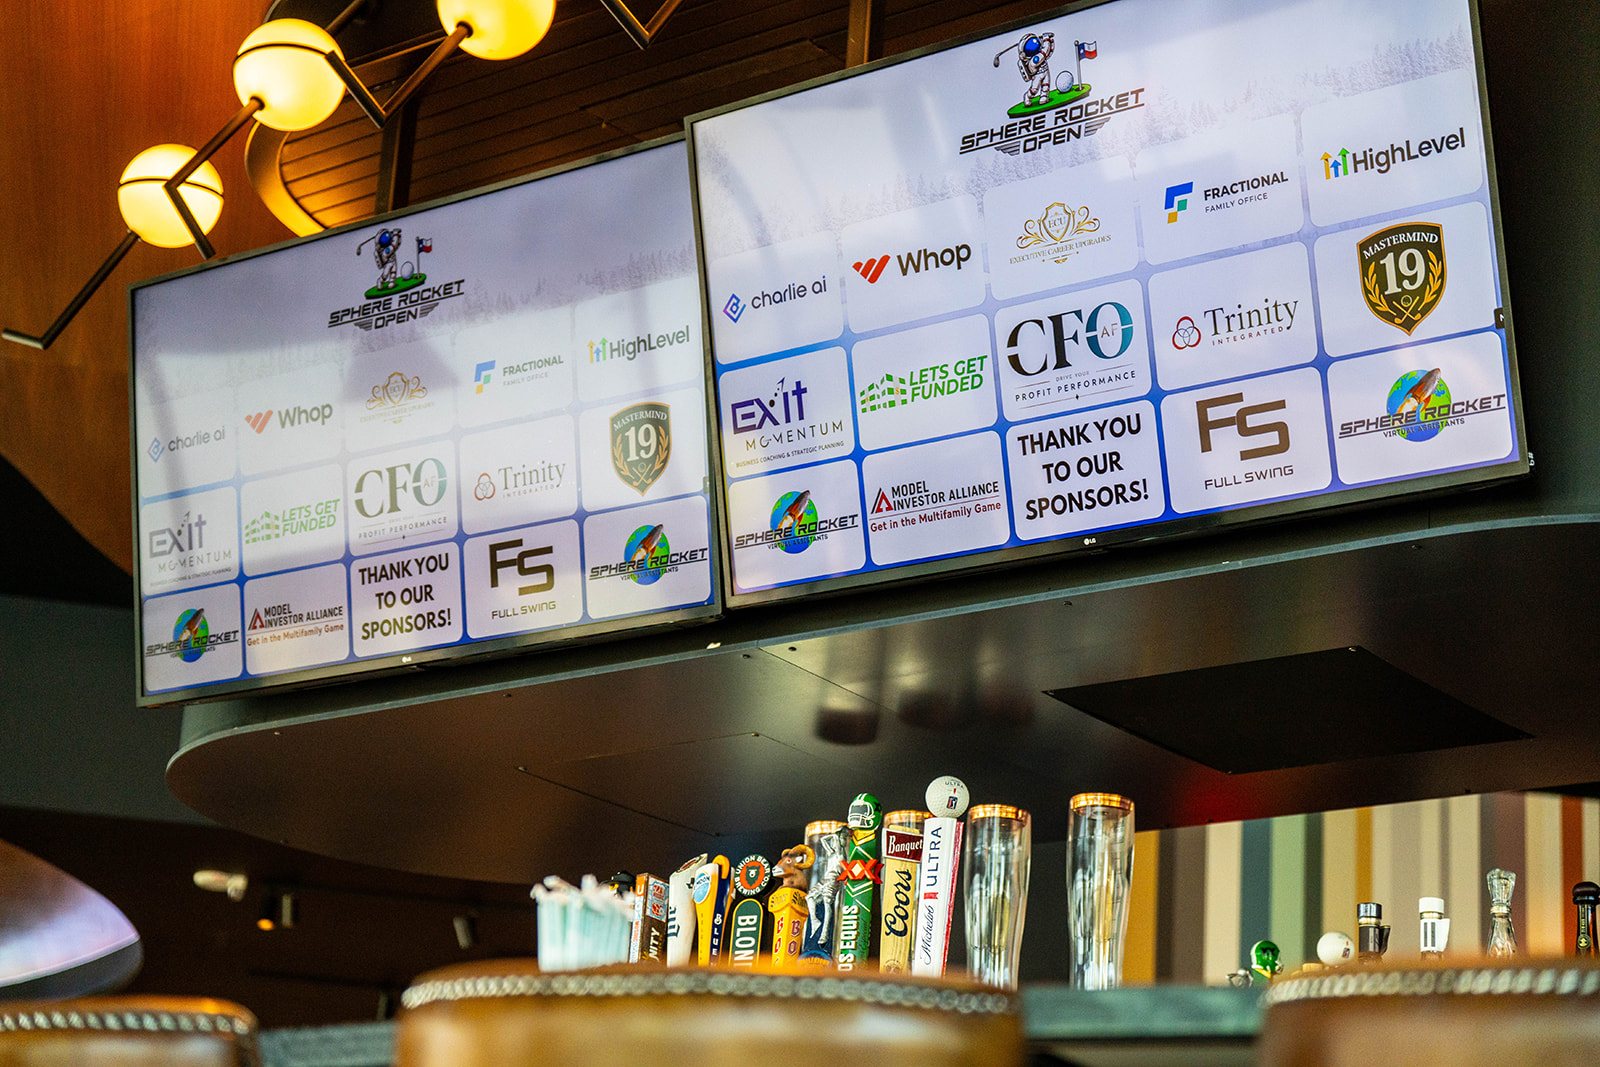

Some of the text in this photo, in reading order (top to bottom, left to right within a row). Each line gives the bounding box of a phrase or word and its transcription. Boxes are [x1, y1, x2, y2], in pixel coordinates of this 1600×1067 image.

[960, 88, 1144, 150] SPHERE ROCKET
[1023, 125, 1081, 153] OPEN
[1352, 127, 1466, 174] HighLevel
[1204, 171, 1289, 202] FRACTIONAL
[1204, 192, 1268, 214] FAMILY OFFICE
[897, 243, 971, 276] Whop
[1362, 231, 1438, 259] MASTERMIND
[1379, 247, 1426, 296] 19
[329, 279, 465, 324] SPHERE ROCKET
[751, 275, 827, 309] charlie ai
[374, 308, 418, 330] OPEN
[1101, 323, 1118, 338] AF
[1203, 297, 1299, 337] Trinity
[610, 325, 690, 360] HighLevel
[1007, 301, 1134, 377] CFO
[1212, 325, 1284, 346] INTEGRATED
[503, 355, 564, 376] FRACTIONAL
[910, 355, 988, 386] LETS GET
[911, 373, 984, 402] FUNDED
[1015, 370, 1136, 402] PROFIT PERFORMANCE
[278, 403, 333, 429] Whop
[613, 410, 668, 432] MASTERMIND
[1196, 392, 1290, 461] FS
[1339, 394, 1506, 435] SPHERE ROCKET
[168, 425, 225, 452] charlie ai
[624, 423, 657, 462] 19
[1017, 413, 1141, 456] THANK YOU
[1383, 426, 1415, 438] VIRTUAL
[498, 460, 566, 490] Trinity
[1042, 451, 1124, 484] TO OUR
[1205, 465, 1294, 490] FULL SWING
[354, 458, 447, 518] CFO
[892, 481, 929, 498] MODEL
[893, 481, 999, 511] INVESTOR ALLIANCE
[1026, 478, 1149, 520] SPONSORS!
[281, 498, 341, 523] LETS GET
[389, 516, 447, 534] PERFORMANCE
[870, 502, 1001, 532] Get in the Multifamily Game
[281, 515, 336, 537] FUNDED
[735, 514, 858, 547] SPHERE ROCKET
[359, 552, 449, 586] THANK YOU
[488, 538, 555, 596] FS
[590, 548, 708, 578] SPHERE ROCKET
[264, 604, 292, 618] MODEL
[375, 584, 435, 610] TO OUR
[491, 600, 556, 620] FULL SWING
[265, 606, 343, 628] INVESTOR ALLIANCE
[361, 608, 452, 640] SPONSORS!
[193, 630, 239, 647] ROCKET
[888, 835, 923, 856] Banquet
[926, 827, 943, 887] ULTRA
[737, 855, 771, 875] UNION BEAR
[734, 877, 760, 895] BREWING
[884, 869, 912, 938] Coors
[734, 915, 757, 966] BLON
[838, 905, 858, 972] OS EQUIS
